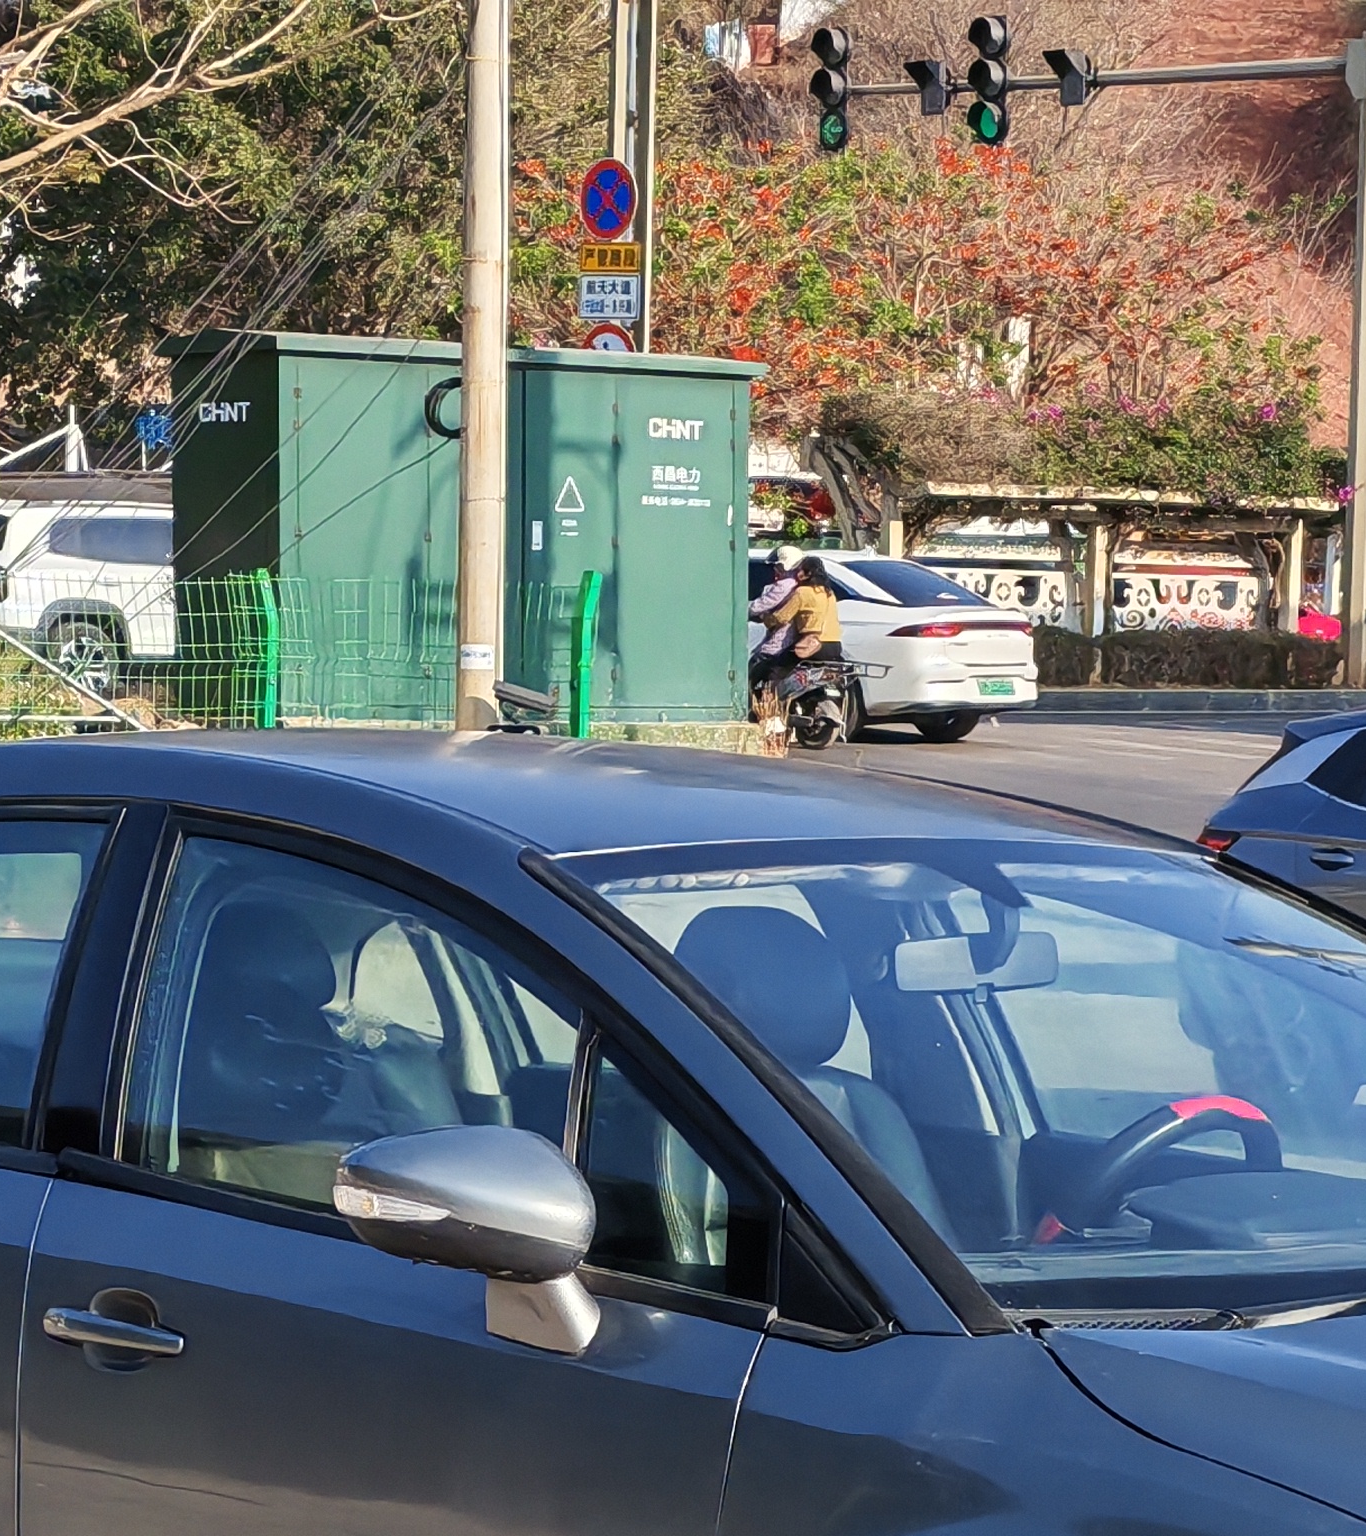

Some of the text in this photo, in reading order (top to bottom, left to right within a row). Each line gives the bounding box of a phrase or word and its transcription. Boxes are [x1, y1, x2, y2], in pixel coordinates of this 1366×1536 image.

[199, 401, 251, 422] CHNT
[648, 417, 703, 440] CHNT
[651, 465, 701, 483] 西昌电力
